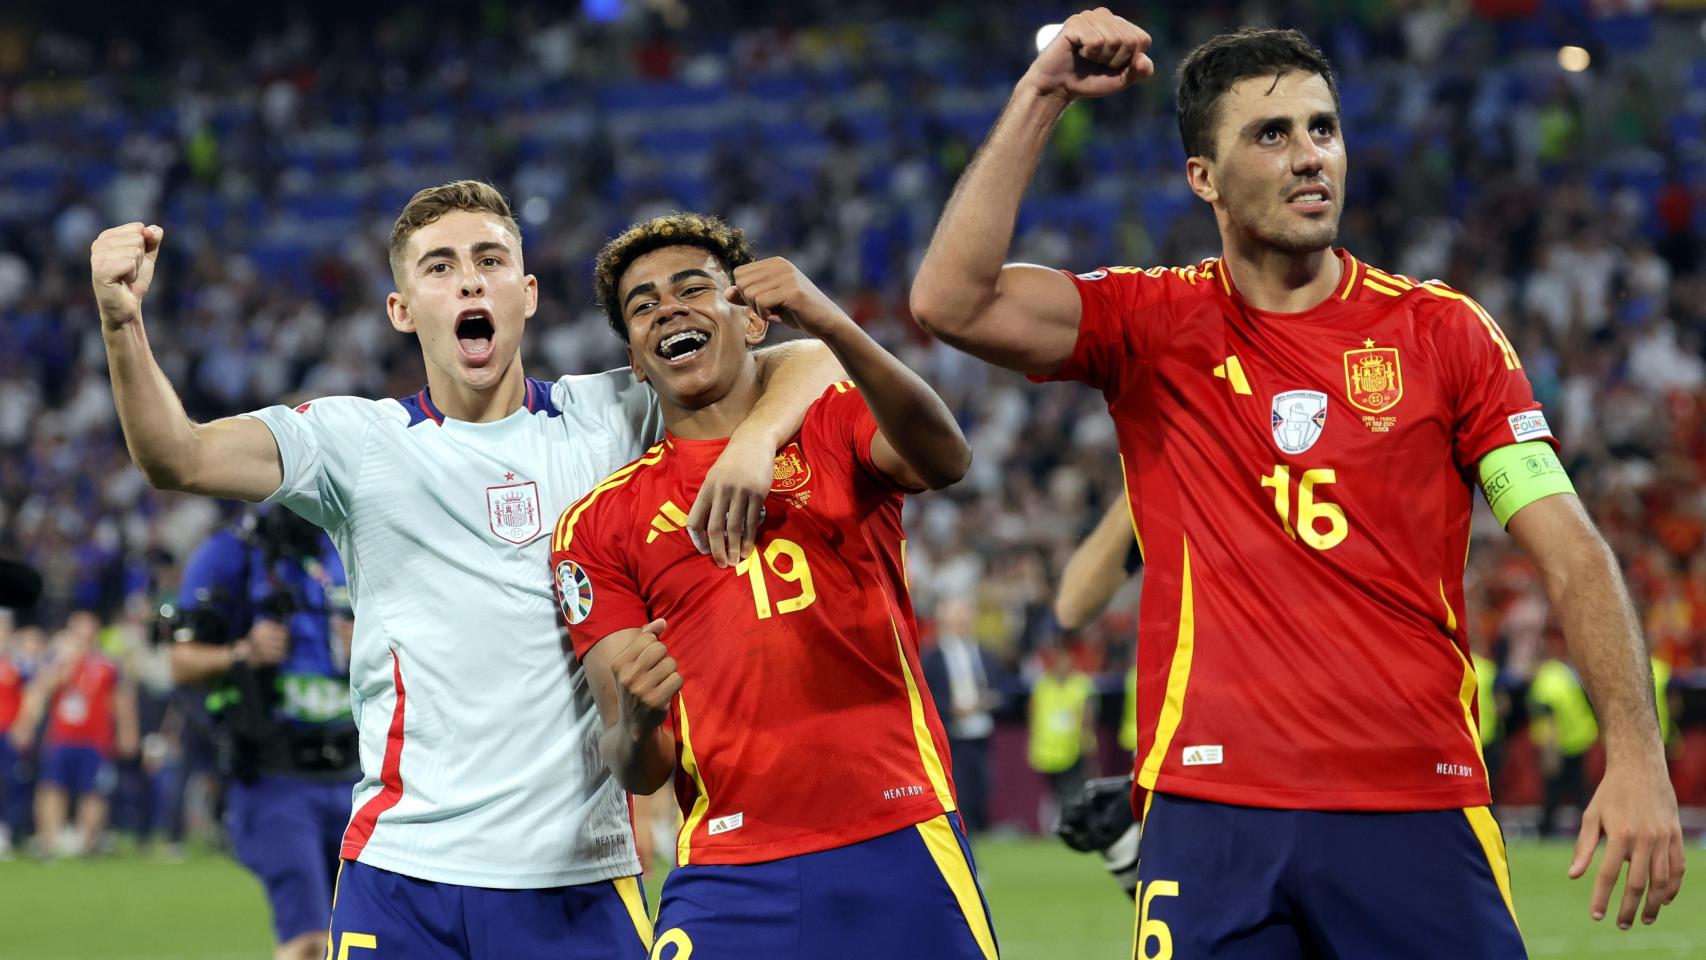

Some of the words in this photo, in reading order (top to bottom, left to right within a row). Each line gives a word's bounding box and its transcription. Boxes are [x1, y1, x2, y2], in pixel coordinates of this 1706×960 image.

[1511, 414, 1527, 423] UEFA
[1261, 465, 1348, 550] 16
[735, 538, 816, 619] 19
[1436, 763, 1473, 777] HEAT.RDY
[883, 785, 923, 800] HEAT.RDY
